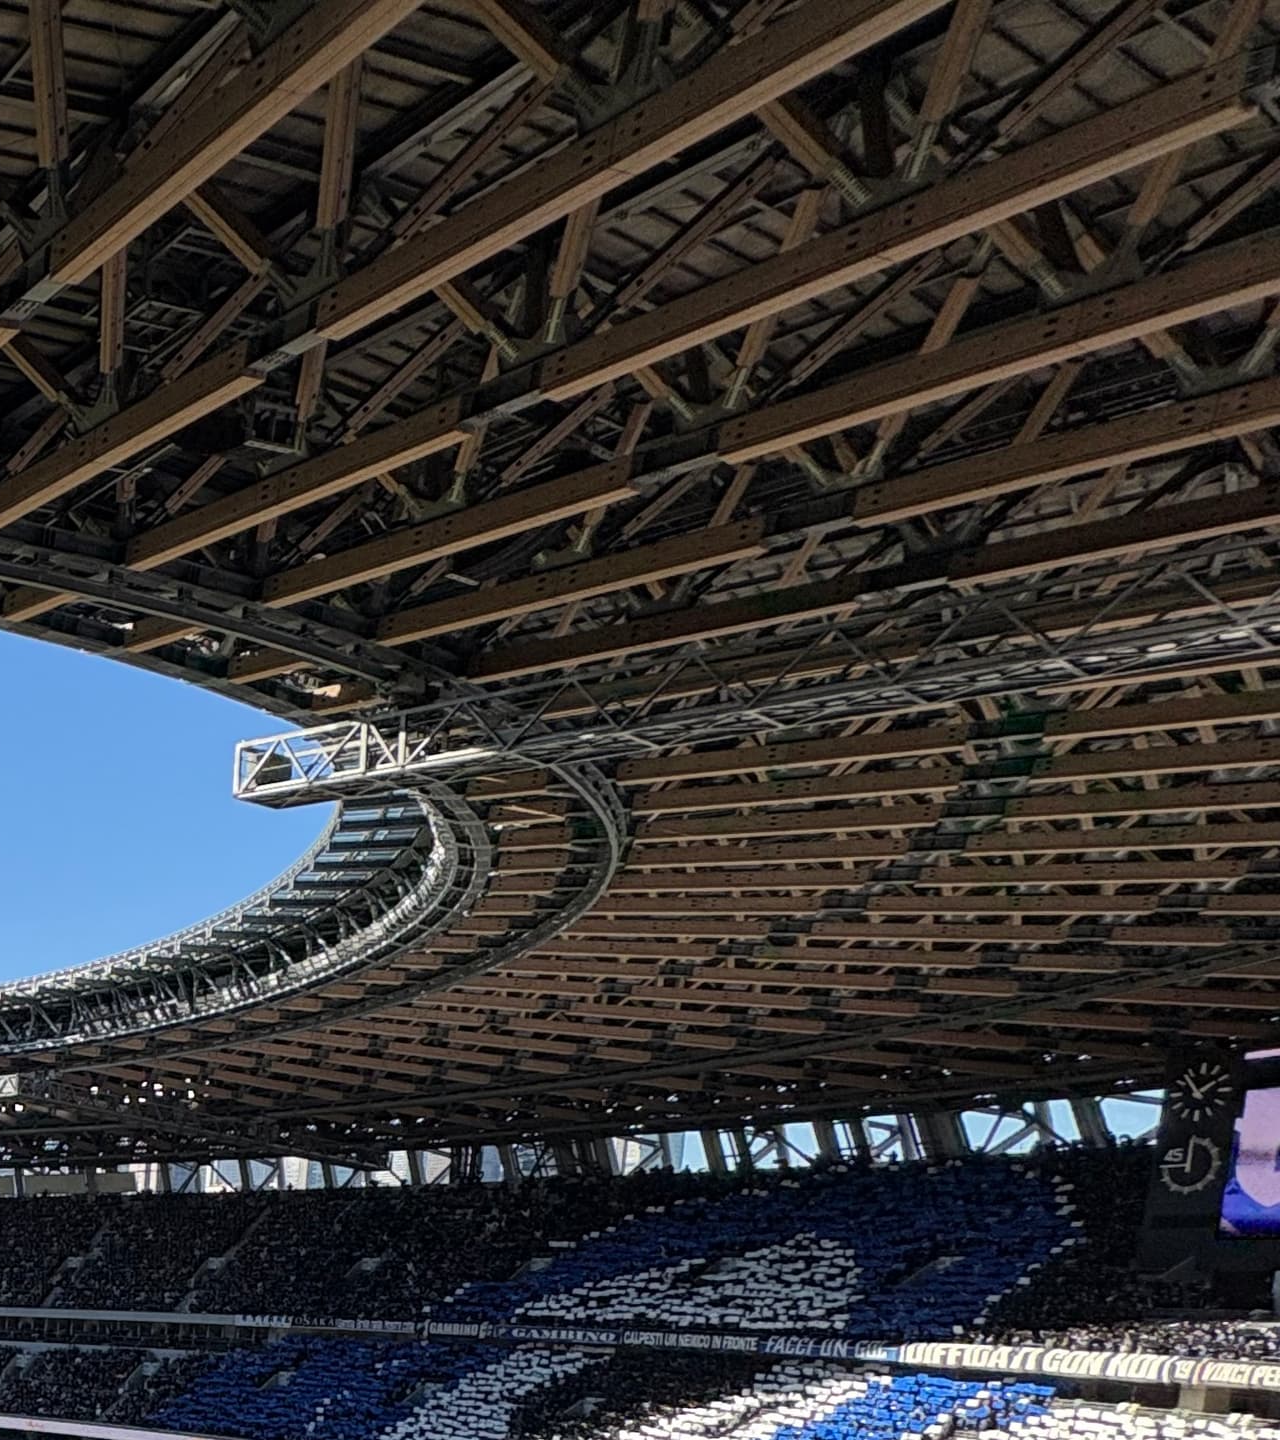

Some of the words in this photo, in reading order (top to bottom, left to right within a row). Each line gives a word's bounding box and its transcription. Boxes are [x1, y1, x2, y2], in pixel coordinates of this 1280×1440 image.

[1163, 1147, 1185, 1162] 45
[428, 1321, 479, 1336] GAMBINO
[510, 1327, 618, 1344] GAMBINO
